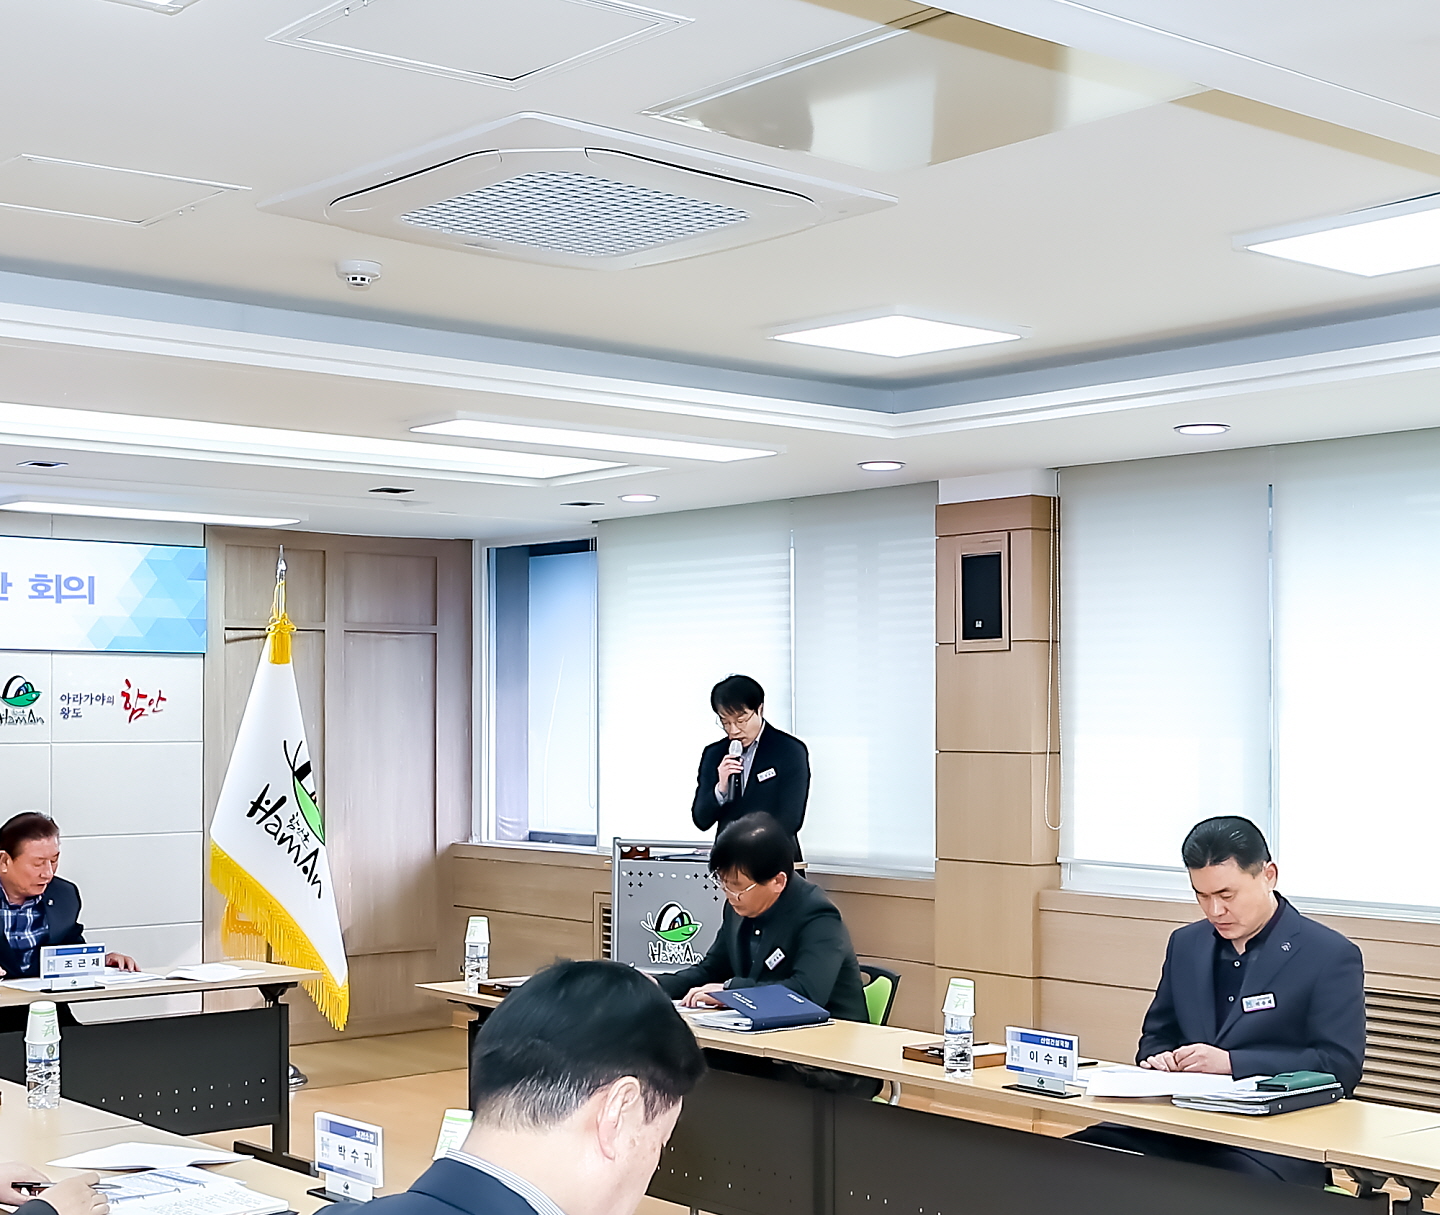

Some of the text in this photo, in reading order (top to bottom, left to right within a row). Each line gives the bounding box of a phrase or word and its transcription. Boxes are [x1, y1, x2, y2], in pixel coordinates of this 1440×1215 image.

[27, 574, 95, 605] 회의
[60, 692, 115, 706] 아라가야의
[121, 678, 167, 724] 함안
[60, 707, 83, 720] 왕도
[246, 783, 322, 899] HamAn
[64, 957, 99, 968] 조근제
[1029, 1050, 1068, 1068] 이수태
